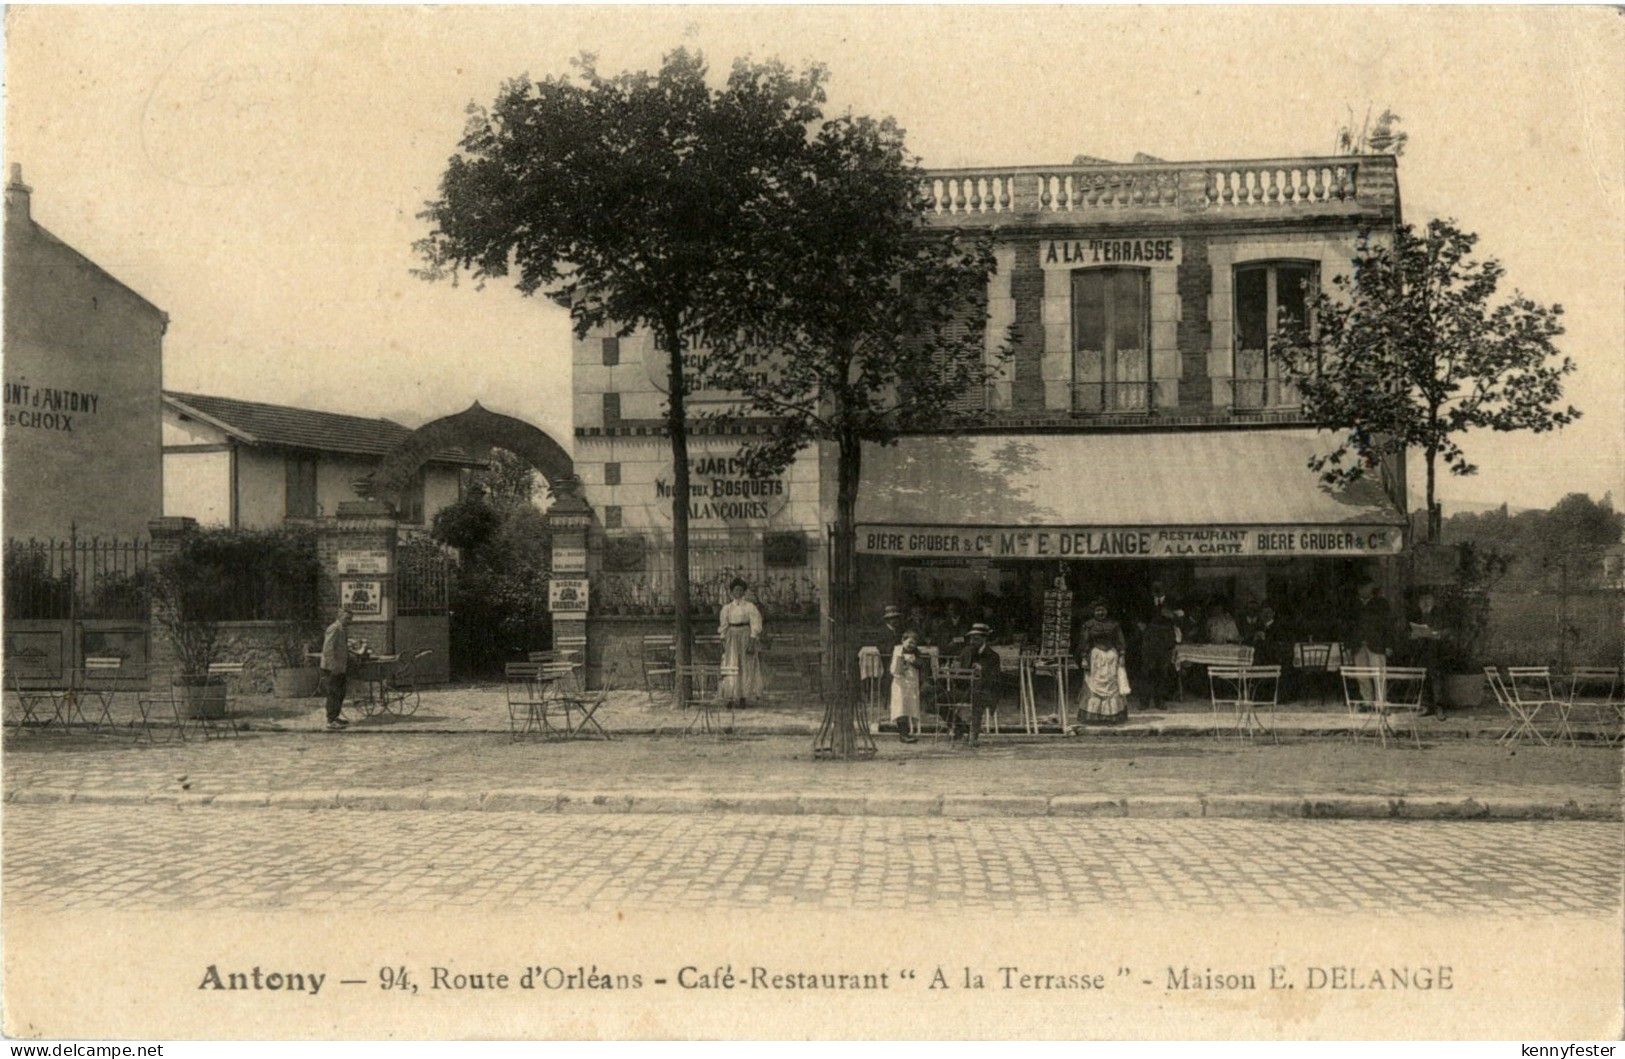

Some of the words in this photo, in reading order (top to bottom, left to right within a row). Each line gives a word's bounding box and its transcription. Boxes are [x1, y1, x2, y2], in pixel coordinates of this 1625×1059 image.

[1063, 241, 1085, 264] LA
[1088, 239, 1174, 262] TERRASSE
[18, 410, 73, 432] CHOIX
[909, 534, 959, 552] GRUBER
[1060, 532, 1152, 555] DELANGE
[1159, 530, 1248, 541] RESTAURANT
[1300, 532, 1354, 550] GRUBER
[1176, 543, 1195, 554] LA
[1198, 543, 1243, 554] CARTE
